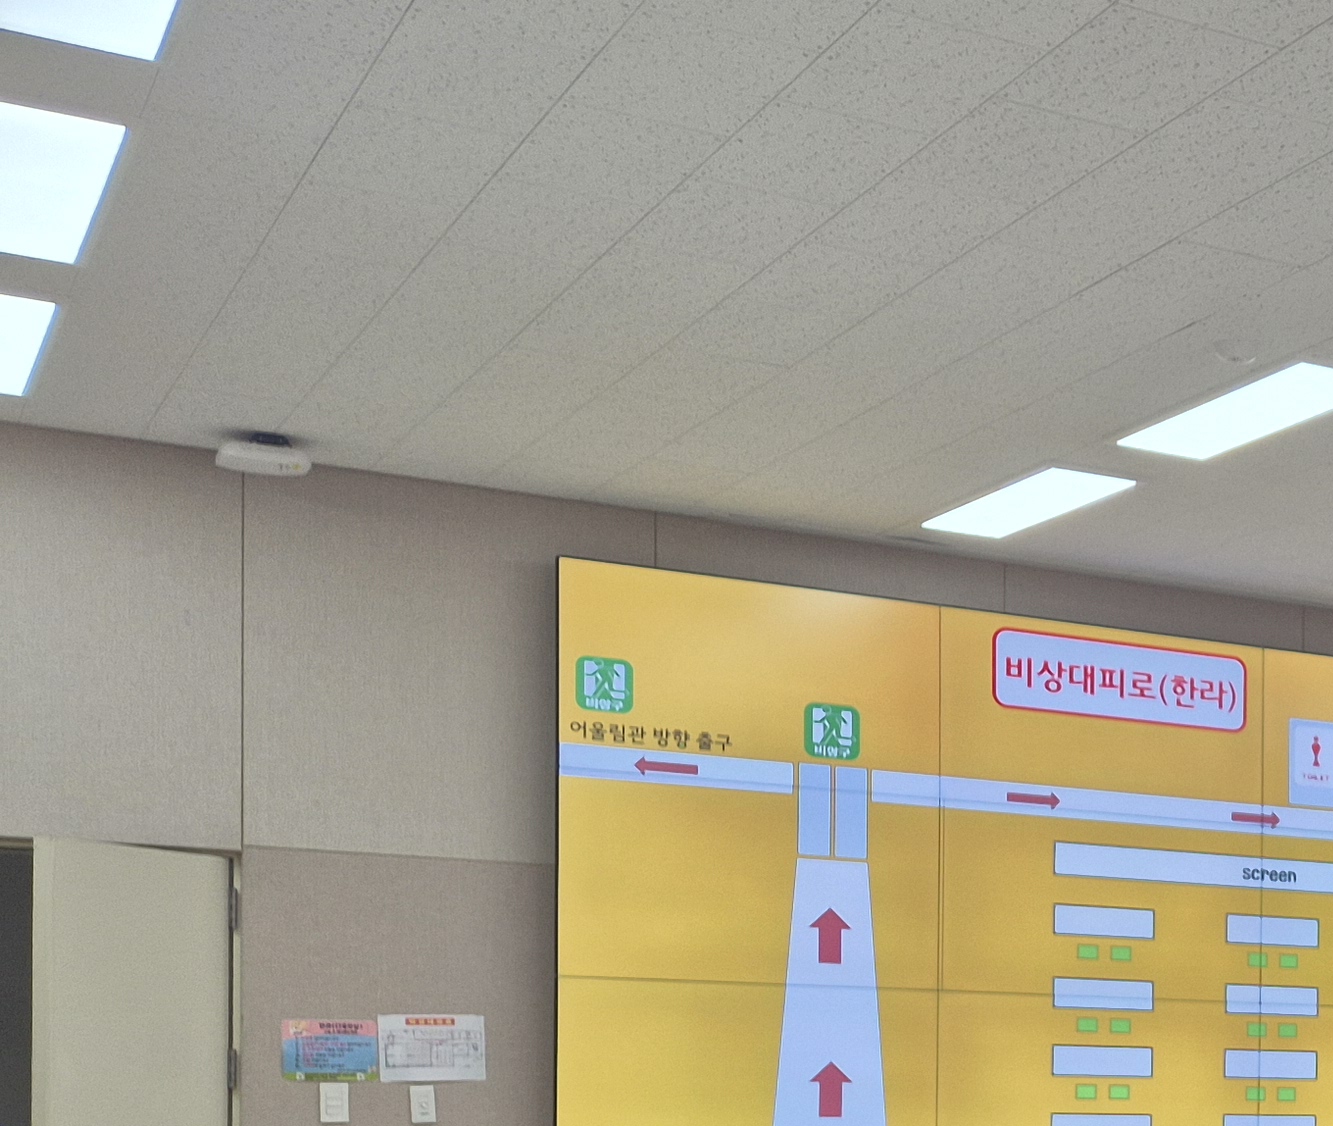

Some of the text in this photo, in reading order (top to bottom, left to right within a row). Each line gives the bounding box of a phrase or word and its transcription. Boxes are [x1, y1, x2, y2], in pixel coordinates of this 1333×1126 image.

[1005, 656, 1237, 713] 비상대피로(한라)
[570, 720, 732, 752] 어울림관 방향 출구
[1242, 866, 1297, 884] screen
